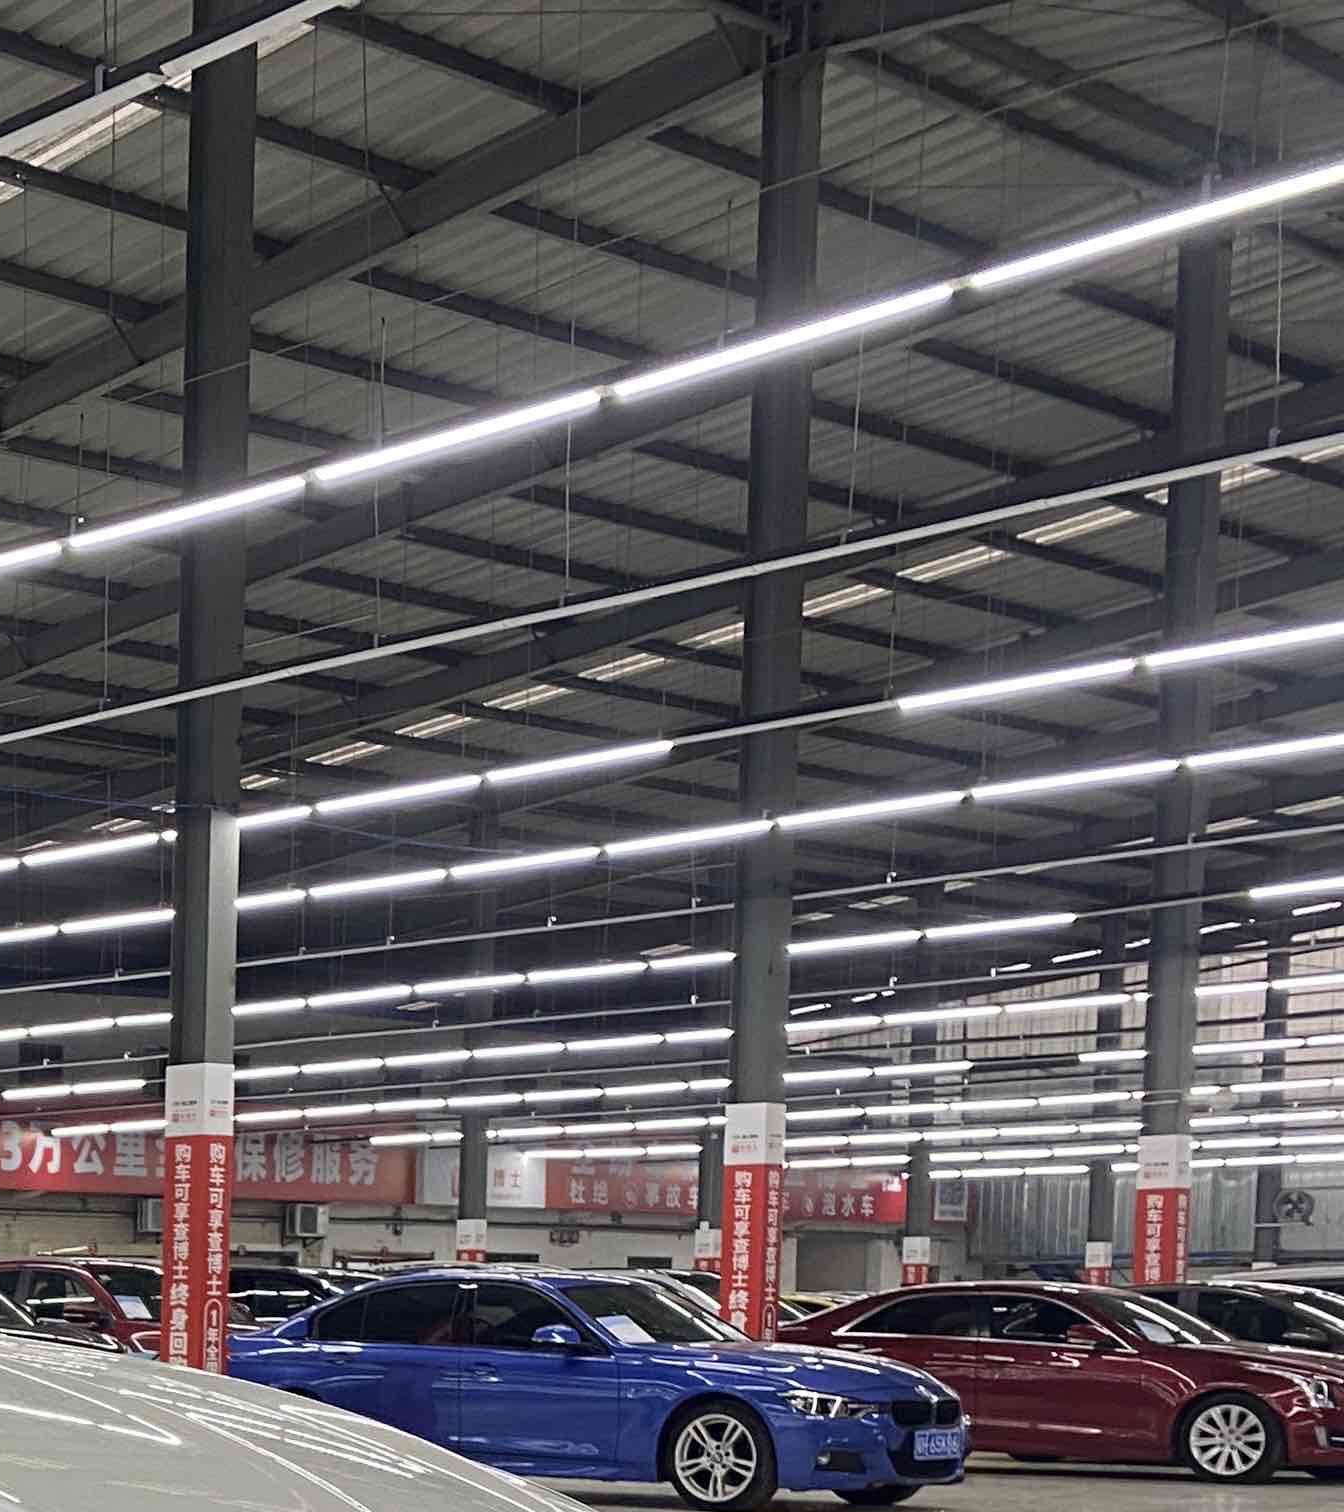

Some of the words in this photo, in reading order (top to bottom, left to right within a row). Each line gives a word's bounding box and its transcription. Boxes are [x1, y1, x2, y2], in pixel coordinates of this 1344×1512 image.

[235, 1132, 379, 1184] 保修服务
[206, 1142, 226, 1296] 购车可享查博士
